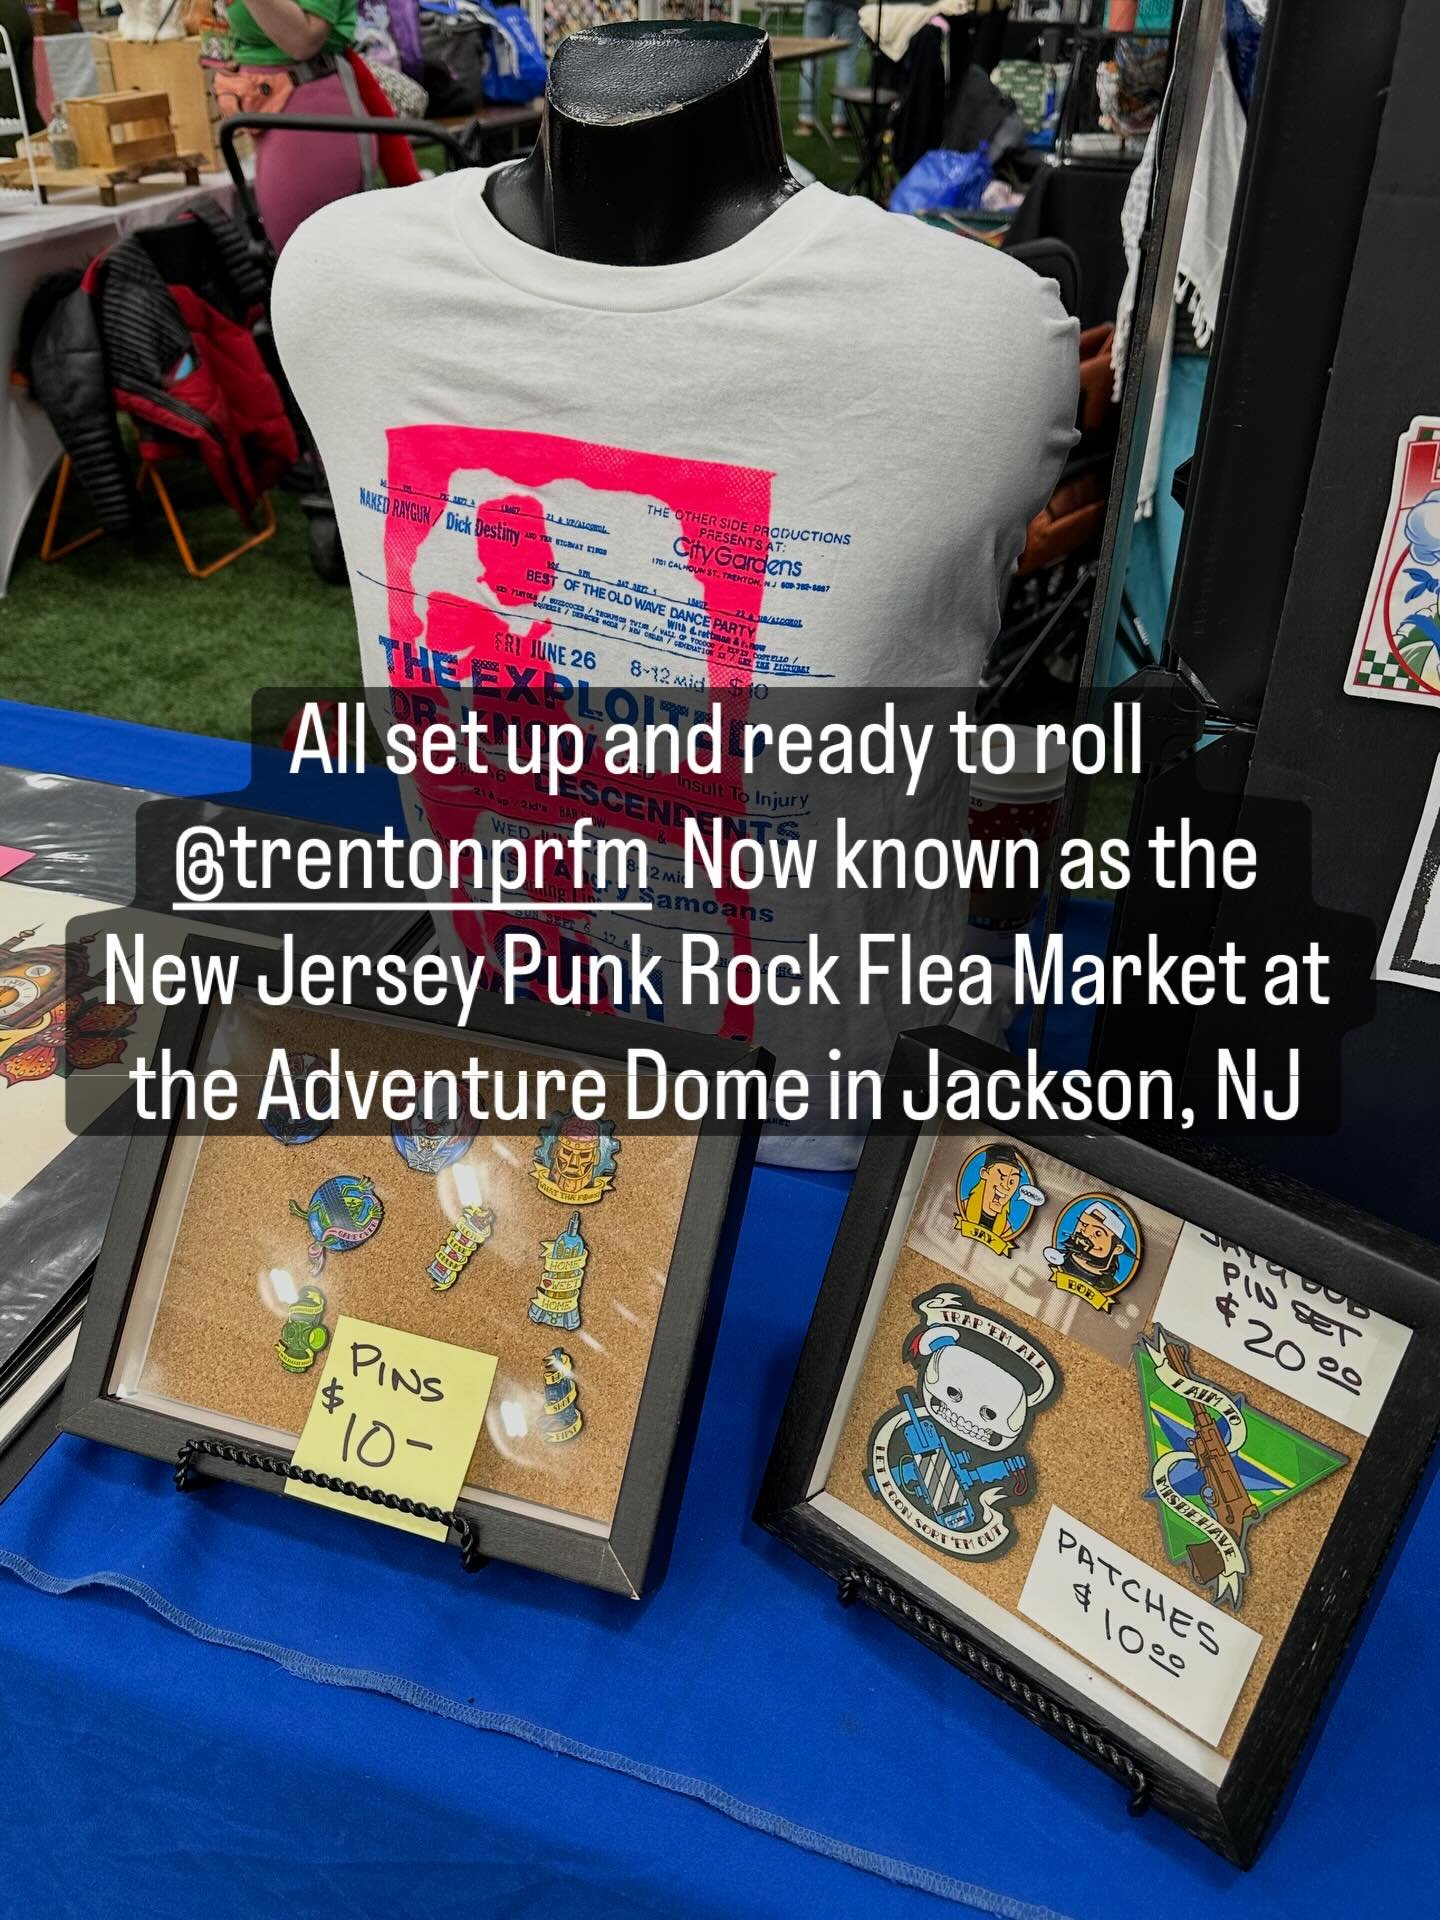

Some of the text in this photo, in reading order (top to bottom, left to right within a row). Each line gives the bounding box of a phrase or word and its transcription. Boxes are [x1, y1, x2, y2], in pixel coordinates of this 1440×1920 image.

[360, 487, 432, 525] NAKED RAYGUN
[647, 504, 852, 546] THE OTHER SIDE PRODUCTIONS
[446, 512, 472, 535] Dick
[474, 517, 520, 547] Destiny
[700, 528, 787, 553] PRESENTS AT:
[652, 558, 667, 568] 1701
[668, 561, 706, 575] CALHOUN
[526, 570, 558, 587] BEST
[564, 578, 580, 592] OF
[583, 583, 606, 600] THE
[608, 590, 632, 606] OLD
[635, 597, 666, 617] WAVE
[670, 607, 711, 628] DANCE
[713, 617, 756, 639] PARTY
[533, 602, 561, 613] SQUEEZE
[572, 611, 600, 624] DEPECHE
[602, 619, 619, 630] MODE
[629, 627, 641, 635] NEW
[644, 631, 664, 643] ORDER
[674, 641, 714, 656] GENERATION
[630, 618, 649, 630] TWINS
[660, 628, 676, 638] WALL
[691, 637, 716, 649] VOODOO
[753, 653, 789, 664] COSTELLO
[667, 619, 687, 633] With
[379, 634, 461, 692] THE
[530, 640, 567, 666] JUNE
[571, 648, 597, 670] 26
[728, 677, 769, 701] $10
[677, 771, 810, 812] Insult To Injury
[491, 817, 531, 840] WED
[560, 806, 578, 819] BAR
[547, 914, 576, 930] SEPT
[583, 923, 592, 933] 6
[639, 887, 774, 925] Samoans
[970, 1228, 995, 1245] JAY
[550, 1259, 582, 1270] HOME
[542, 1301, 572, 1311] HOME
[1068, 1278, 1096, 1301] BOB
[1222, 1261, 1363, 1347] PIN SET
[940, 1310, 1047, 1371] TRAP 'EM ALL
[351, 1342, 445, 1402] PINS
[1171, 1378, 1242, 1427] I AIM TO
[875, 1445, 1003, 1551] LET EGON SORT 'EM OUT
[1155, 1474, 1238, 1562] MISBEHAVE
[1058, 1527, 1220, 1656] PATCHES
